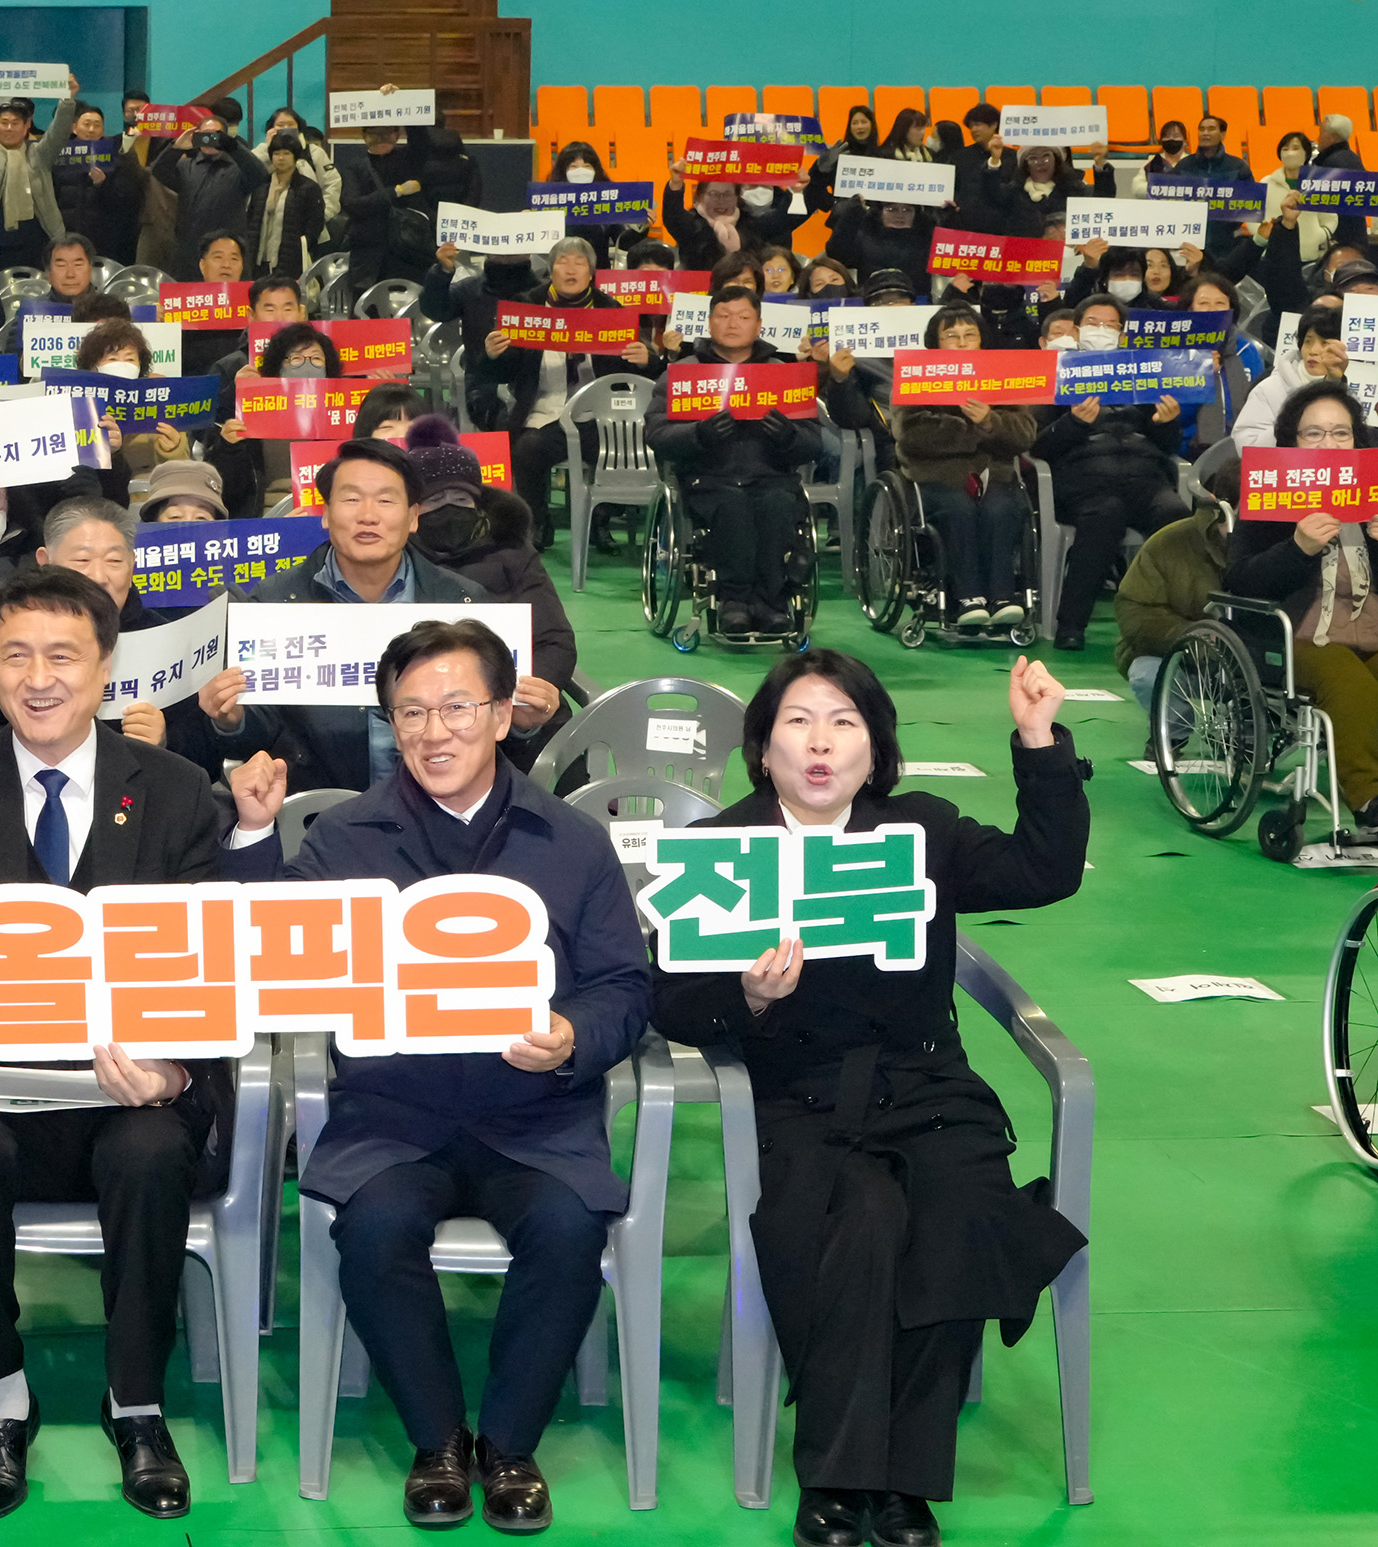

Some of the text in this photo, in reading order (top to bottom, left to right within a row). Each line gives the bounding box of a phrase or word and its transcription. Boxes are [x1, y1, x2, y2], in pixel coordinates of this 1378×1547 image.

[1071, 211, 1114, 225] 전북 전주
[1182, 222, 1202, 235] 기원
[957, 244, 986, 257] 전주의
[163, 294, 214, 310] 전북 전주의
[501, 315, 552, 329] 전북 전주의
[834, 321, 880, 336] 전북 전주
[1170, 319, 1193, 332] 희망
[550, 328, 635, 342] 하나 대한민국
[782, 325, 802, 339] 기원
[30, 336, 63, 352] 2036
[364, 342, 406, 359] 대한민국
[900, 362, 958, 377] 전북 전주의
[1059, 360, 1163, 379] 하계올림픽 유치 희망
[671, 377, 729, 395] 전북 전주의
[956, 375, 1047, 392] 하나 되는 대한민국
[1111, 374, 1206, 392] 수도 전북 전주에서
[144, 386, 170, 402] 희망
[730, 385, 815, 408] 하나 되는 대한민국
[133, 398, 212, 419] 전북 전주에서
[30, 432, 67, 457] 기원
[1248, 466, 1358, 488] 전북 전주의 꿈,
[1247, 488, 1361, 510] 올림픽으로 하나
[203, 532, 281, 559] 유치 희망
[190, 560, 267, 587] 수도 전북
[237, 634, 328, 662] 전북 전주
[150, 659, 183, 692] 유치
[191, 635, 219, 669] 기원
[647, 834, 925, 961] 전북
